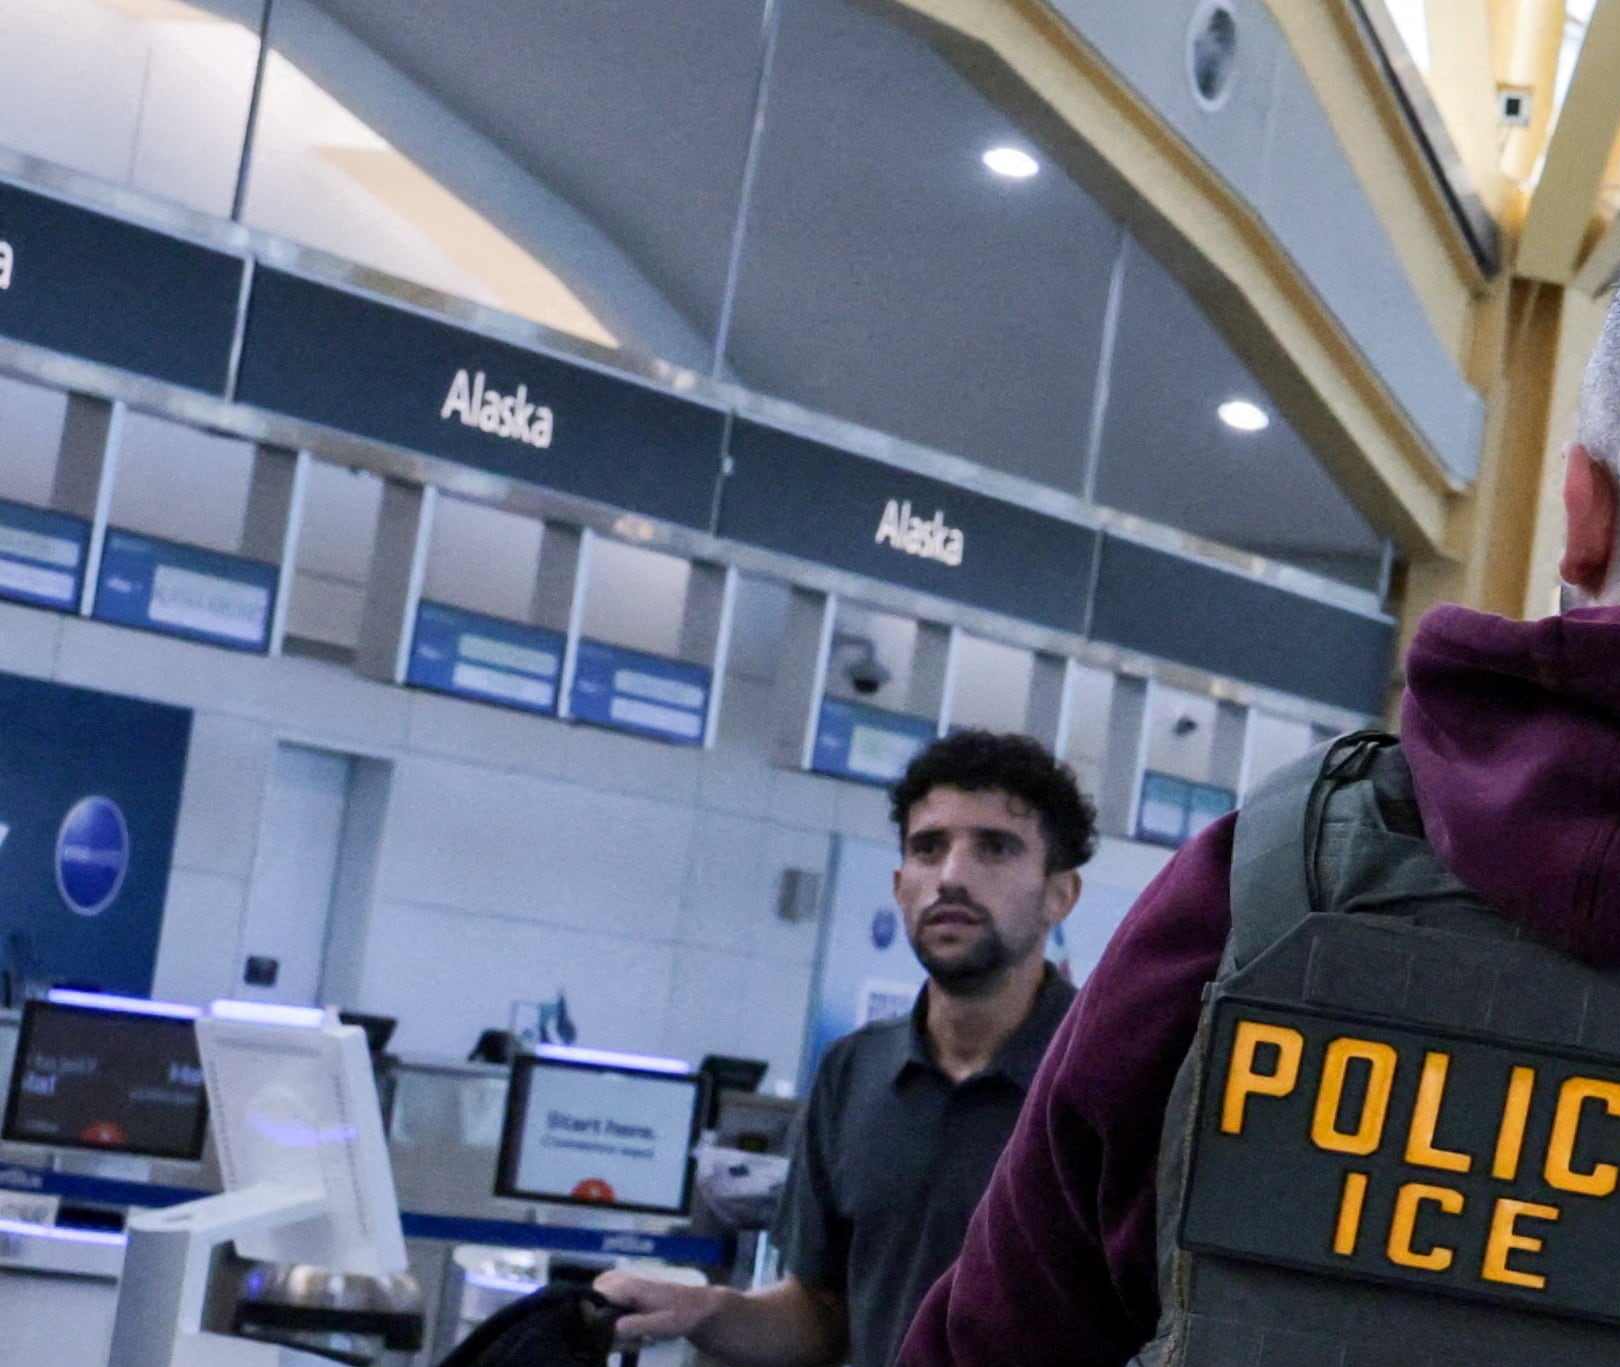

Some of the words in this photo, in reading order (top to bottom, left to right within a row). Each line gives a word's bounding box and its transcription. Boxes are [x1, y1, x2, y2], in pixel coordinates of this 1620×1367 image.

[441, 369, 553, 448] Alaska
[875, 499, 964, 567] Alaska
[1332, 1172, 1560, 1289] ICE
